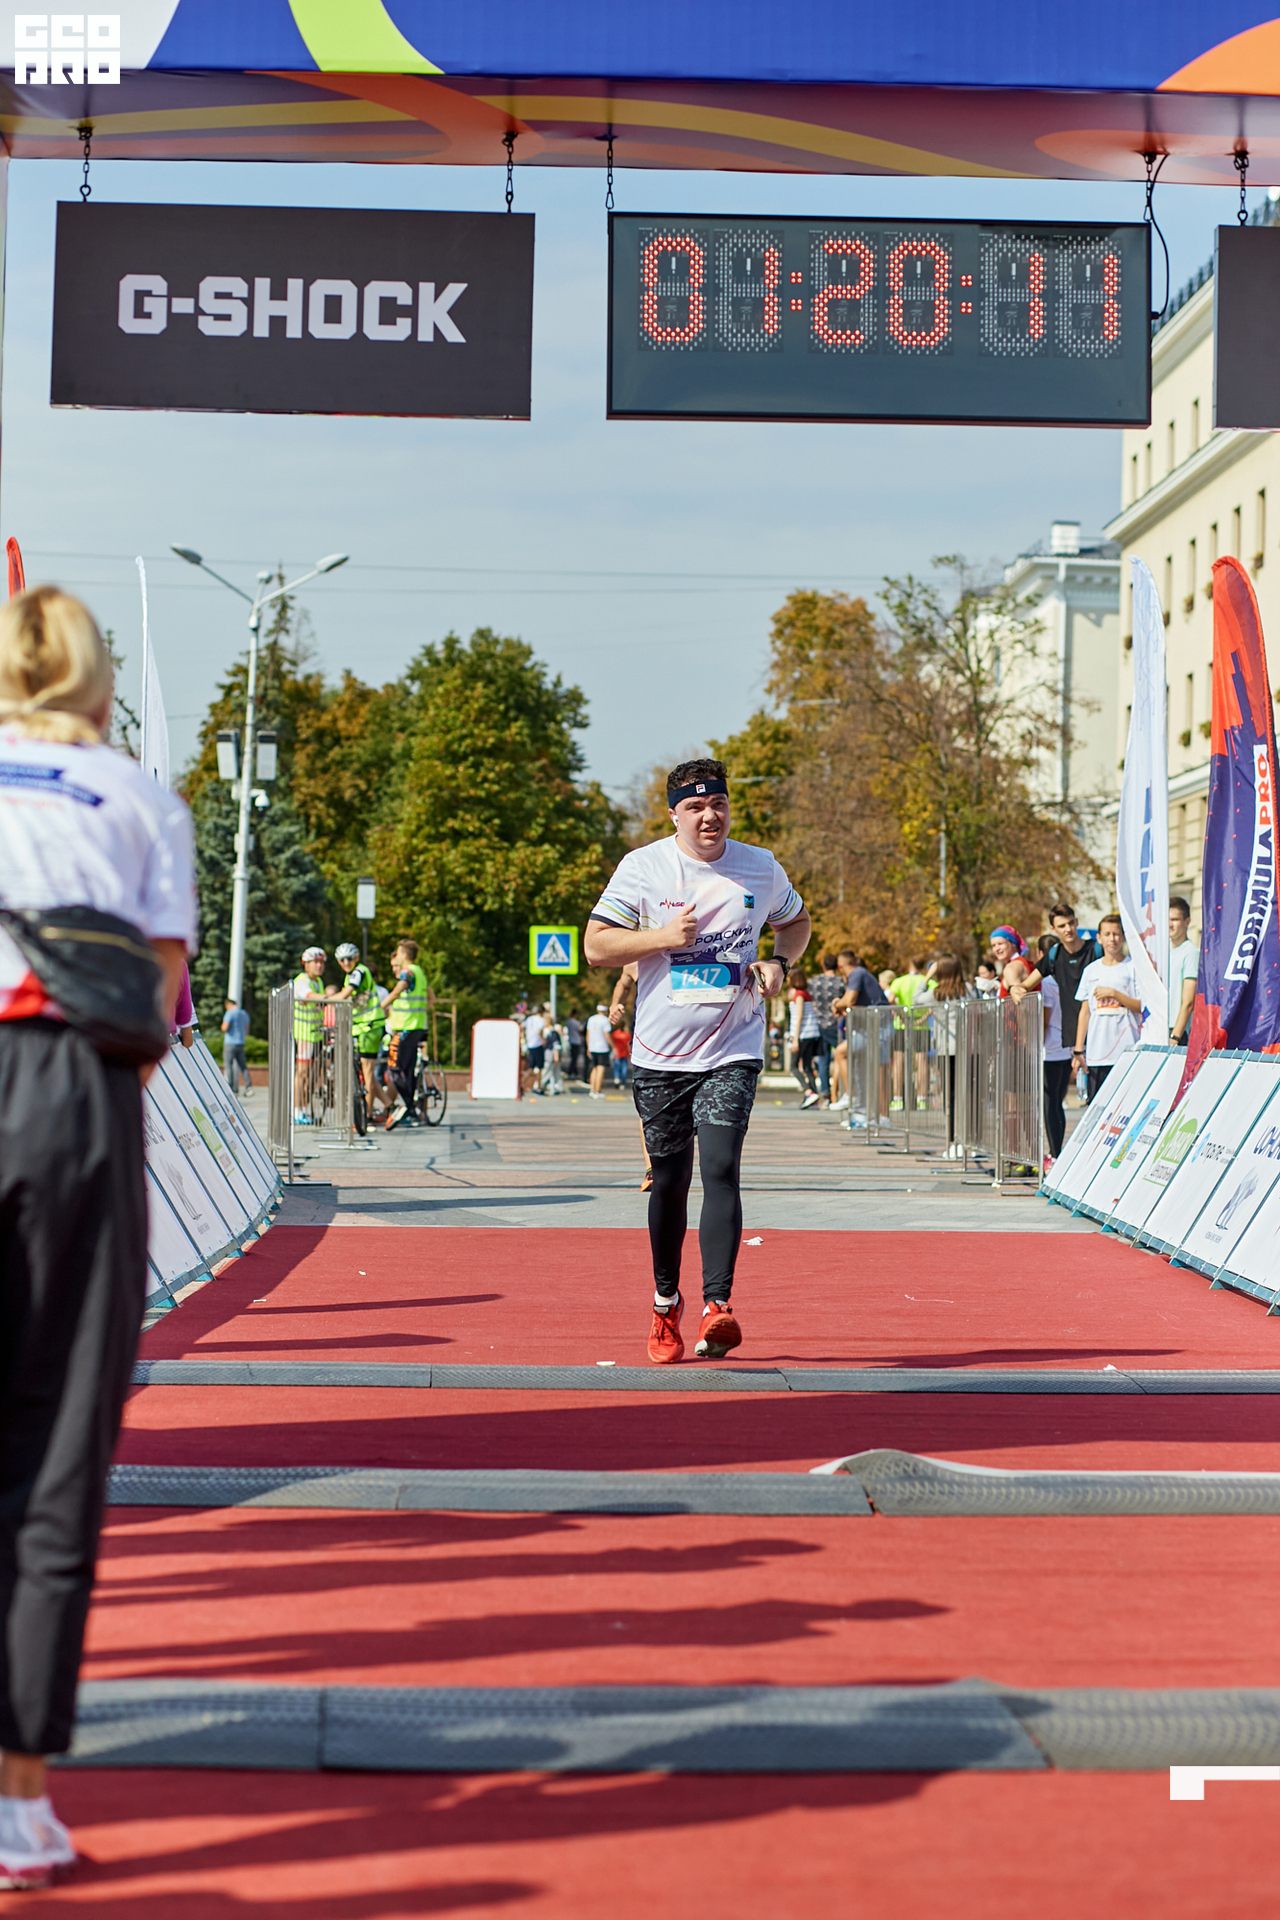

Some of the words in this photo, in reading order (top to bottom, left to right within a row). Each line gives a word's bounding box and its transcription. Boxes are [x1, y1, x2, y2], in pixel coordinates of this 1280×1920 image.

[118, 273, 468, 343] G-SHOCK
[641, 235, 1119, 347] 01:20:11
[688, 924, 753, 948] РОДСКИЙ
[681, 967, 721, 987] 1417
